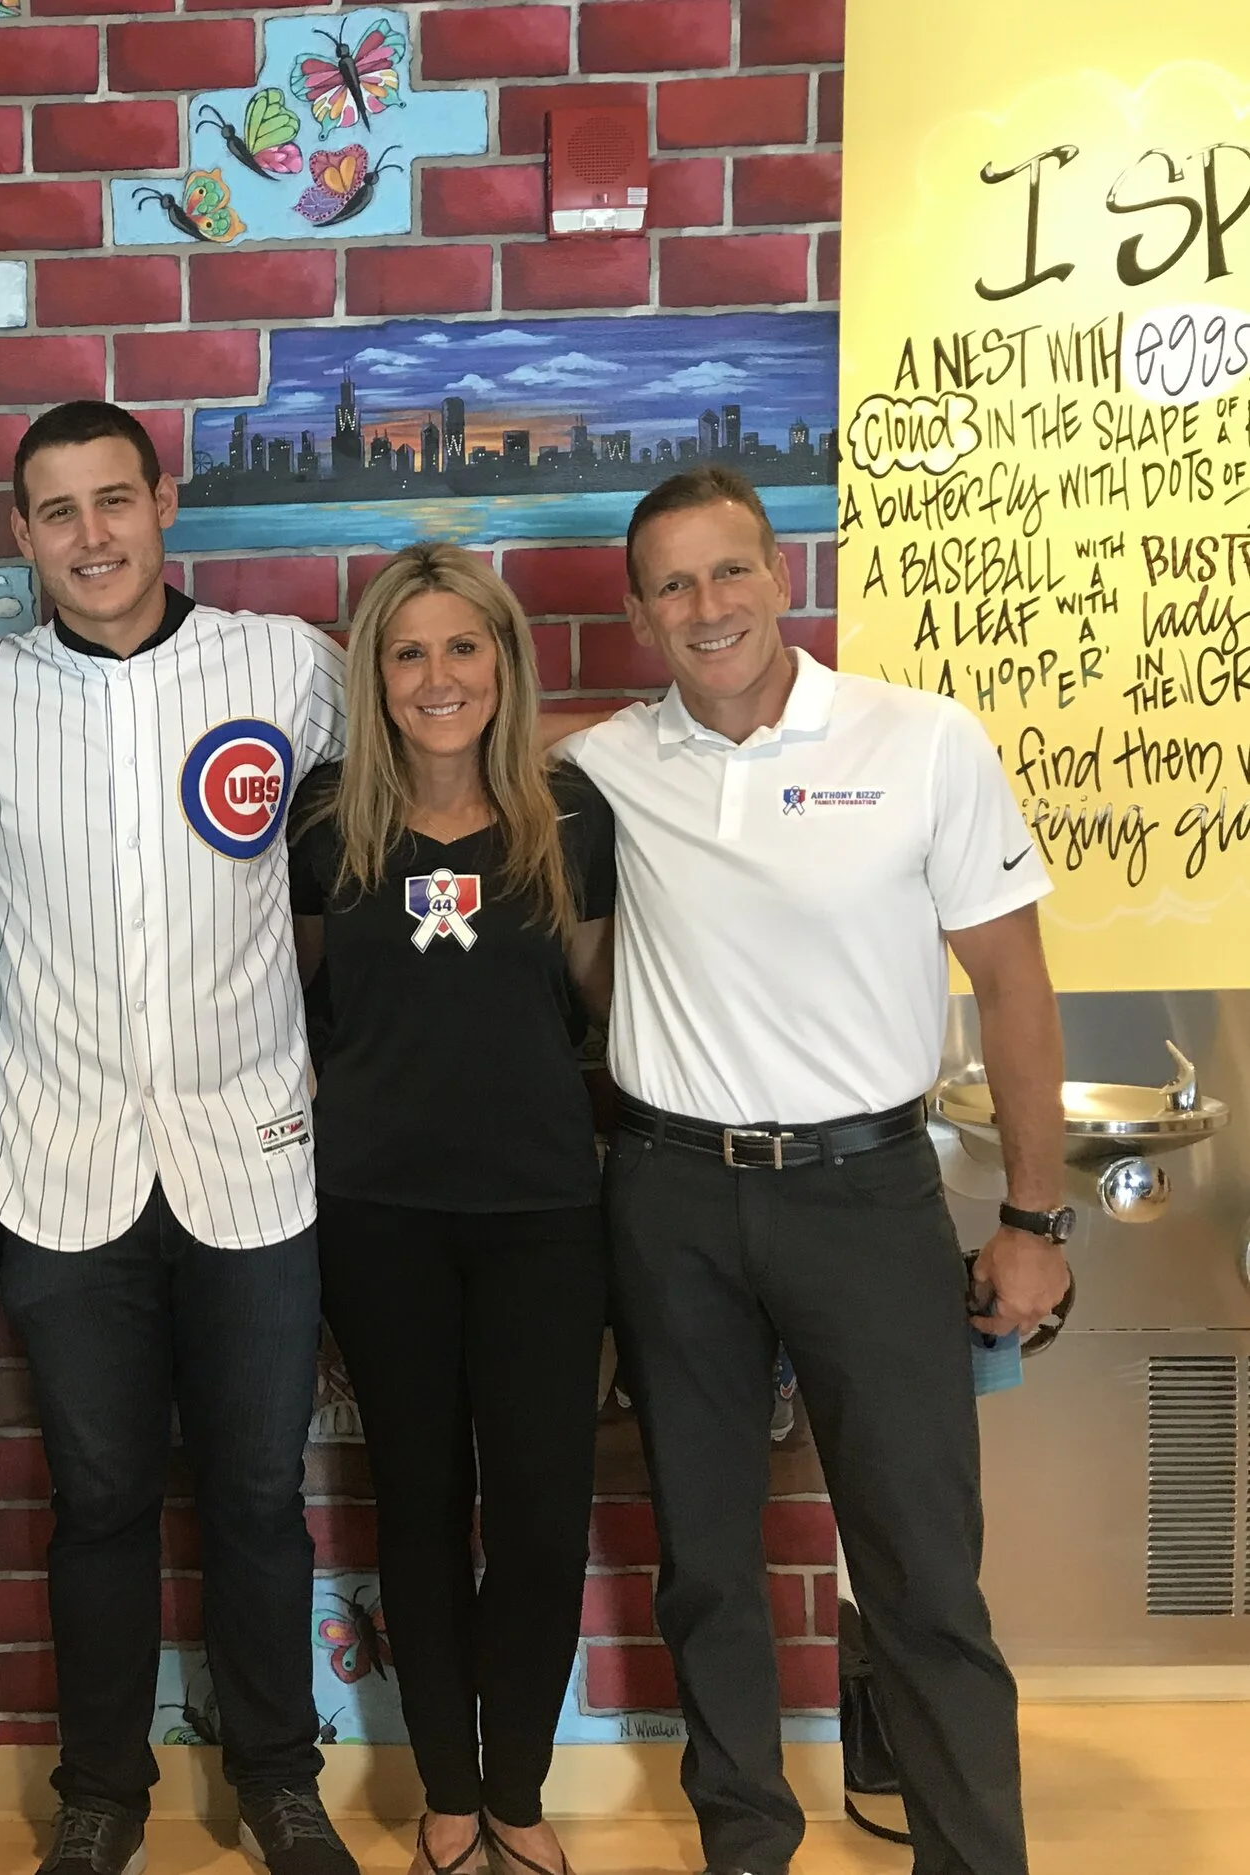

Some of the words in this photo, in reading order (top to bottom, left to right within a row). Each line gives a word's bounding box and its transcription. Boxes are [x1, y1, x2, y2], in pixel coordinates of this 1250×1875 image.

[975, 144, 1079, 301] I
[895, 337, 920, 390] A
[933, 325, 1043, 392] NEST
[1047, 312, 1123, 393] WITH
[987, 399, 1015, 449] IN
[1021, 394, 1082, 450] THE
[1093, 400, 1199, 455] SHAPE
[1217, 396, 1239, 417] OF
[1217, 421, 1231, 444] A
[840, 483, 864, 531] A
[871, 462, 1050, 537] butterfly
[1059, 458, 1129, 510] WITH
[1141, 448, 1214, 509] DOTS
[1223, 461, 1247, 486] OF
[863, 545, 887, 598] A
[900, 536, 1066, 598] BASEBALL
[1075, 531, 1126, 559] WITH
[1090, 562, 1104, 590] A
[914, 599, 940, 651] A
[954, 596, 1041, 647] LEAF
[1056, 588, 1118, 616] WITH
[1079, 617, 1096, 644] A
[937, 659, 956, 698] A
[1136, 648, 1163, 680] IN
[1123, 677, 1177, 715] THE
[1016, 726, 1104, 796] find
[1113, 726, 1222, 793] them
[811, 791, 852, 799] ANTHONY
[432, 899, 452, 912] 44
